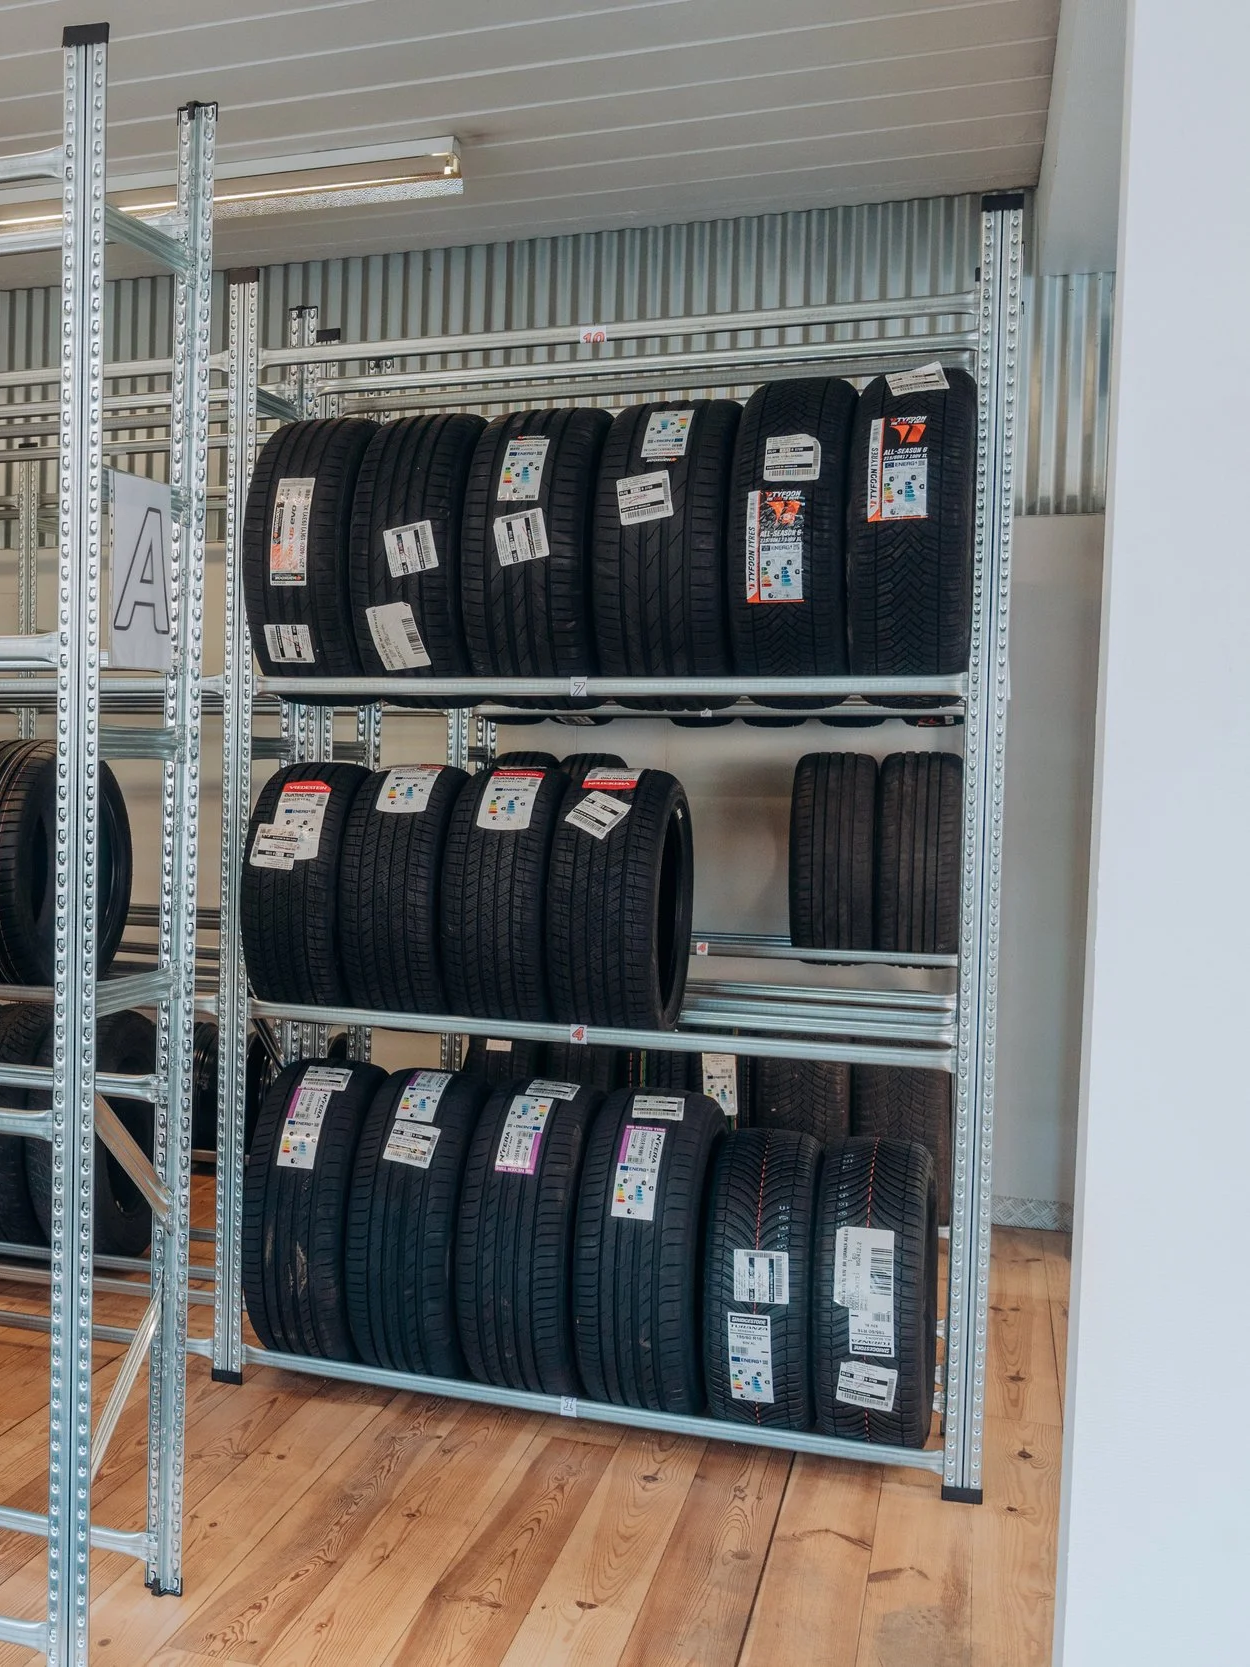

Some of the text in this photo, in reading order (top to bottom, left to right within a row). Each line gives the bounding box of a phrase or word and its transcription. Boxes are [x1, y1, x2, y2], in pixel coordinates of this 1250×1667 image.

[883, 447, 922, 456] ALL-SEASON
[114, 506, 170, 634] A
[573, 682, 585, 696] 7
[698, 942, 705, 952] 4
[572, 1026, 585, 1041] 4
[499, 1132, 511, 1162] N'FERA
[652, 1134, 662, 1164] N'FERA
[564, 1398, 574, 1411] 1
